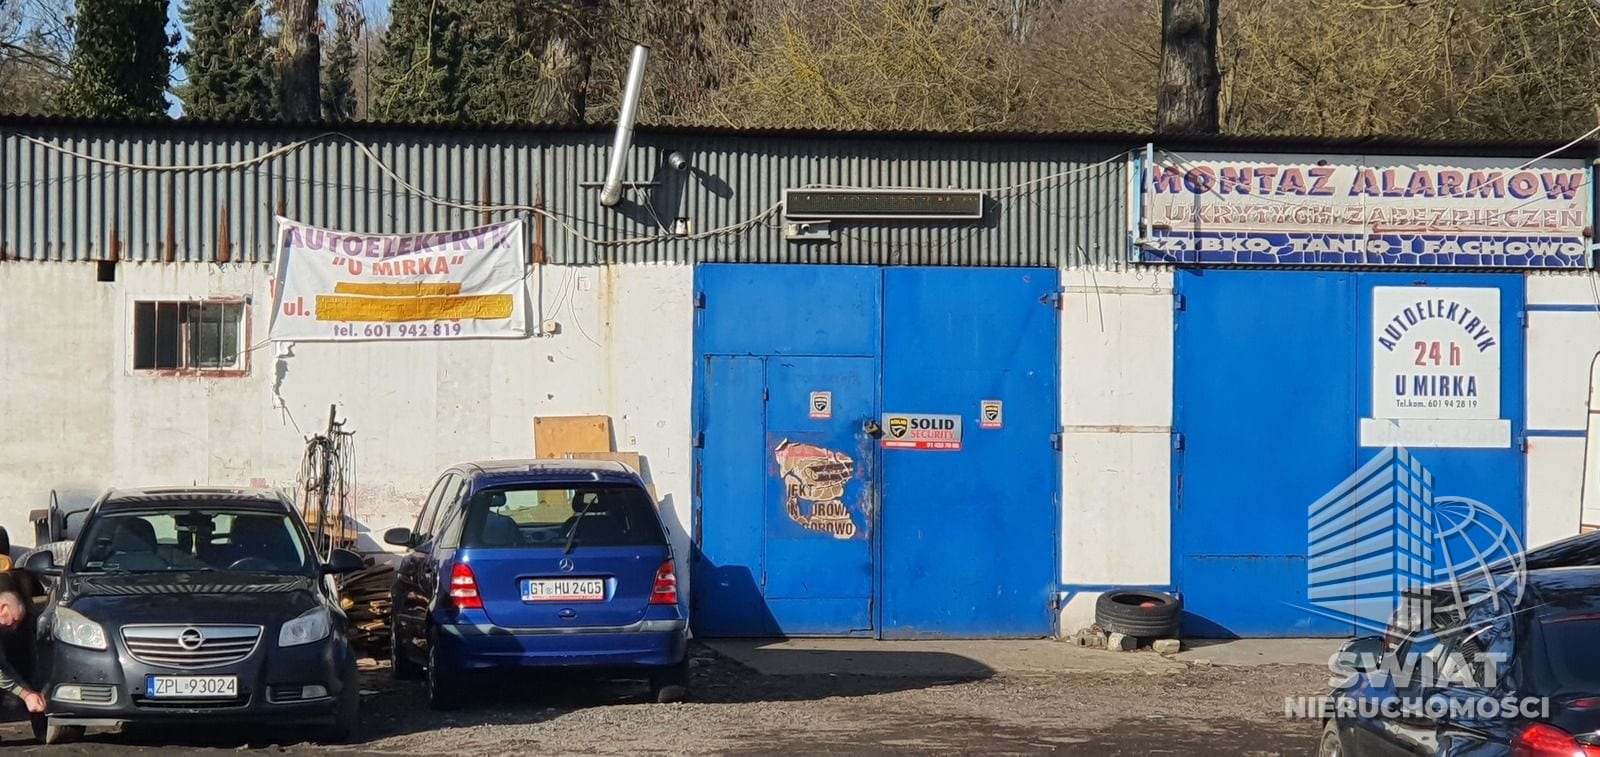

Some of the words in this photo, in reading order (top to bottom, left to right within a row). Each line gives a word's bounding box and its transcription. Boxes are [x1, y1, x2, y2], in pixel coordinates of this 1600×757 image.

[1164, 203, 1334, 225] UKRYTYCH
[1346, 203, 1583, 228] ZABEZPIECZEŃ
[286, 224, 511, 259] AUTOELEKTRYK
[1292, 238, 1390, 253] TANIO
[1400, 239, 1412, 254] I
[1424, 240, 1584, 256] FACHOWO
[283, 297, 311, 316] ul.
[334, 324, 358, 337] tel.
[364, 324, 391, 337] 601
[399, 324, 427, 337] 942
[433, 324, 461, 337] 819
[1378, 299, 1496, 352] AUTOELEKTRYK
[1414, 341, 1441, 366] 24
[1449, 341, 1461, 366] h
[1395, 375, 1406, 396] U
[1414, 375, 1477, 397] MIRKA
[1396, 399, 1427, 408] Tel.kom.
[1428, 399, 1441, 408] 601
[1444, 399, 1454, 408] 94
[1456, 399, 1466, 408] 28
[1468, 399, 1478, 408] 19
[910, 418, 955, 430] SOLID
[911, 430, 955, 439] SECURITY
[531, 582, 545, 594] GT
[555, 582, 569, 594] HU
[573, 582, 601, 594] 2405
[156, 679, 183, 694] ZPL
[190, 679, 235, 694] 93024
